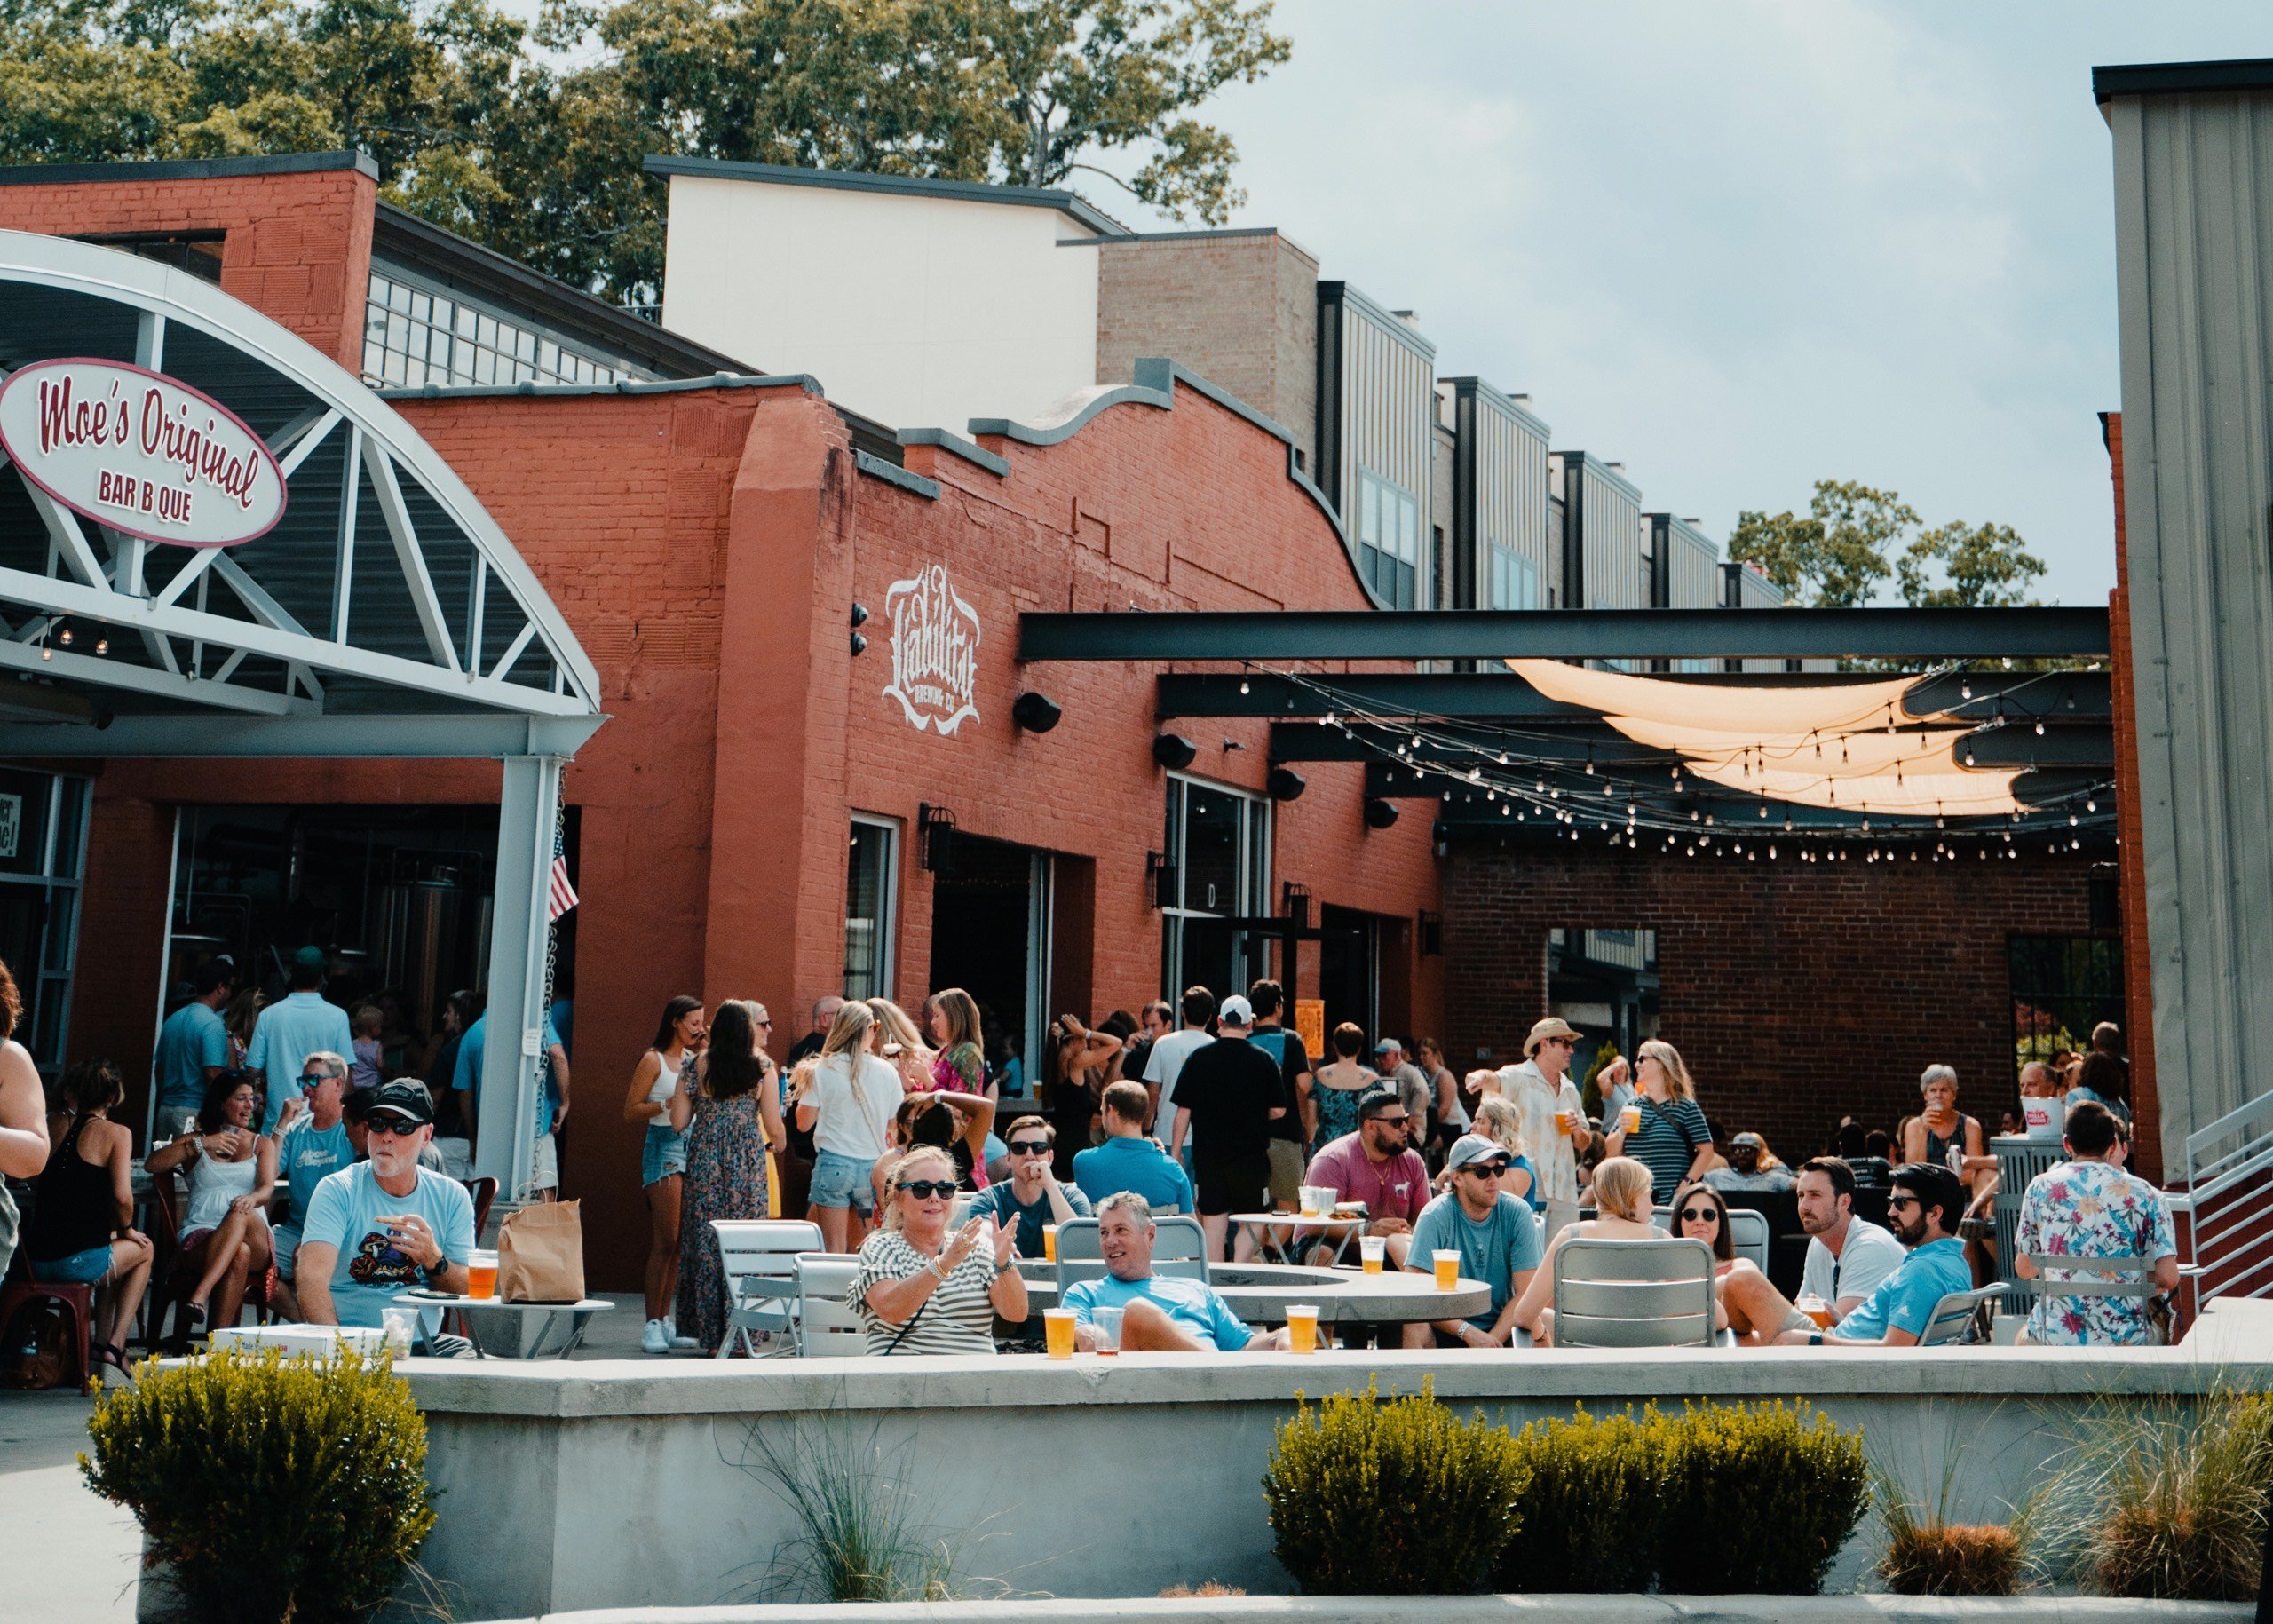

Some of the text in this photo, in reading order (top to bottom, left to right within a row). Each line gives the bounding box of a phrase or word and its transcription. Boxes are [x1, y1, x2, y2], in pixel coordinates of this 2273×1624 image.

[39, 376, 258, 509] Moe's Original
[99, 471, 192, 522] BAR B QUE
[915, 685, 945, 707] BREWING
